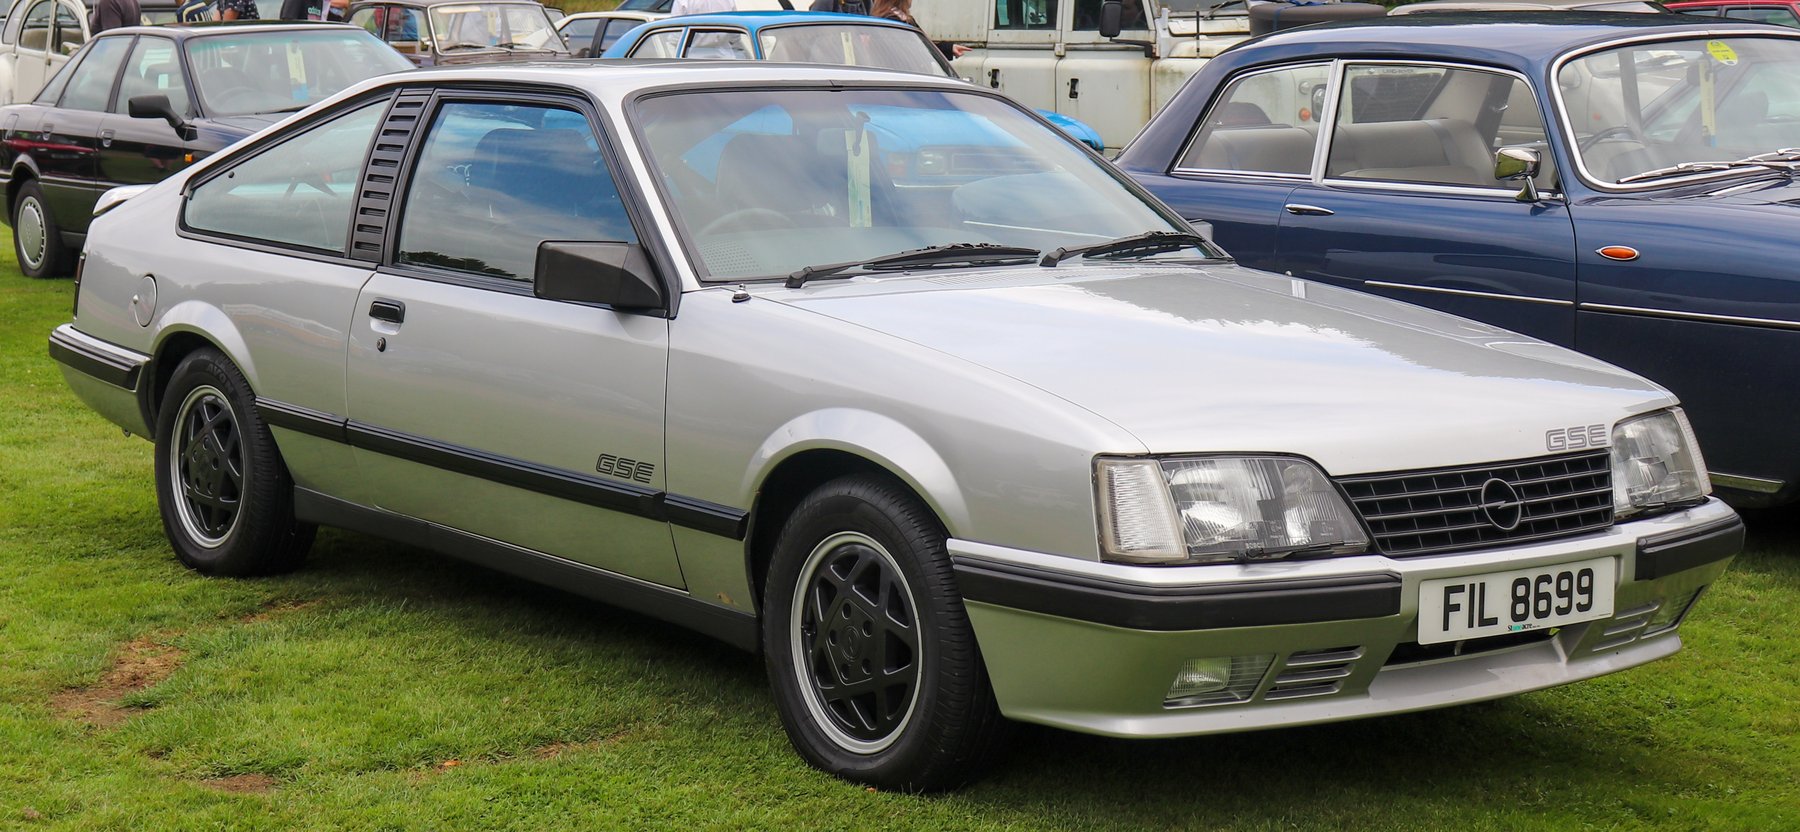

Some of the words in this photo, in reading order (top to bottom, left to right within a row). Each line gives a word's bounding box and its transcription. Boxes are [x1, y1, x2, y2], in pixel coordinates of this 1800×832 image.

[1545, 423, 1608, 452] GSE
[596, 453, 656, 484] GSE
[1443, 582, 1499, 632] FIL
[1510, 567, 1594, 623] 8699
